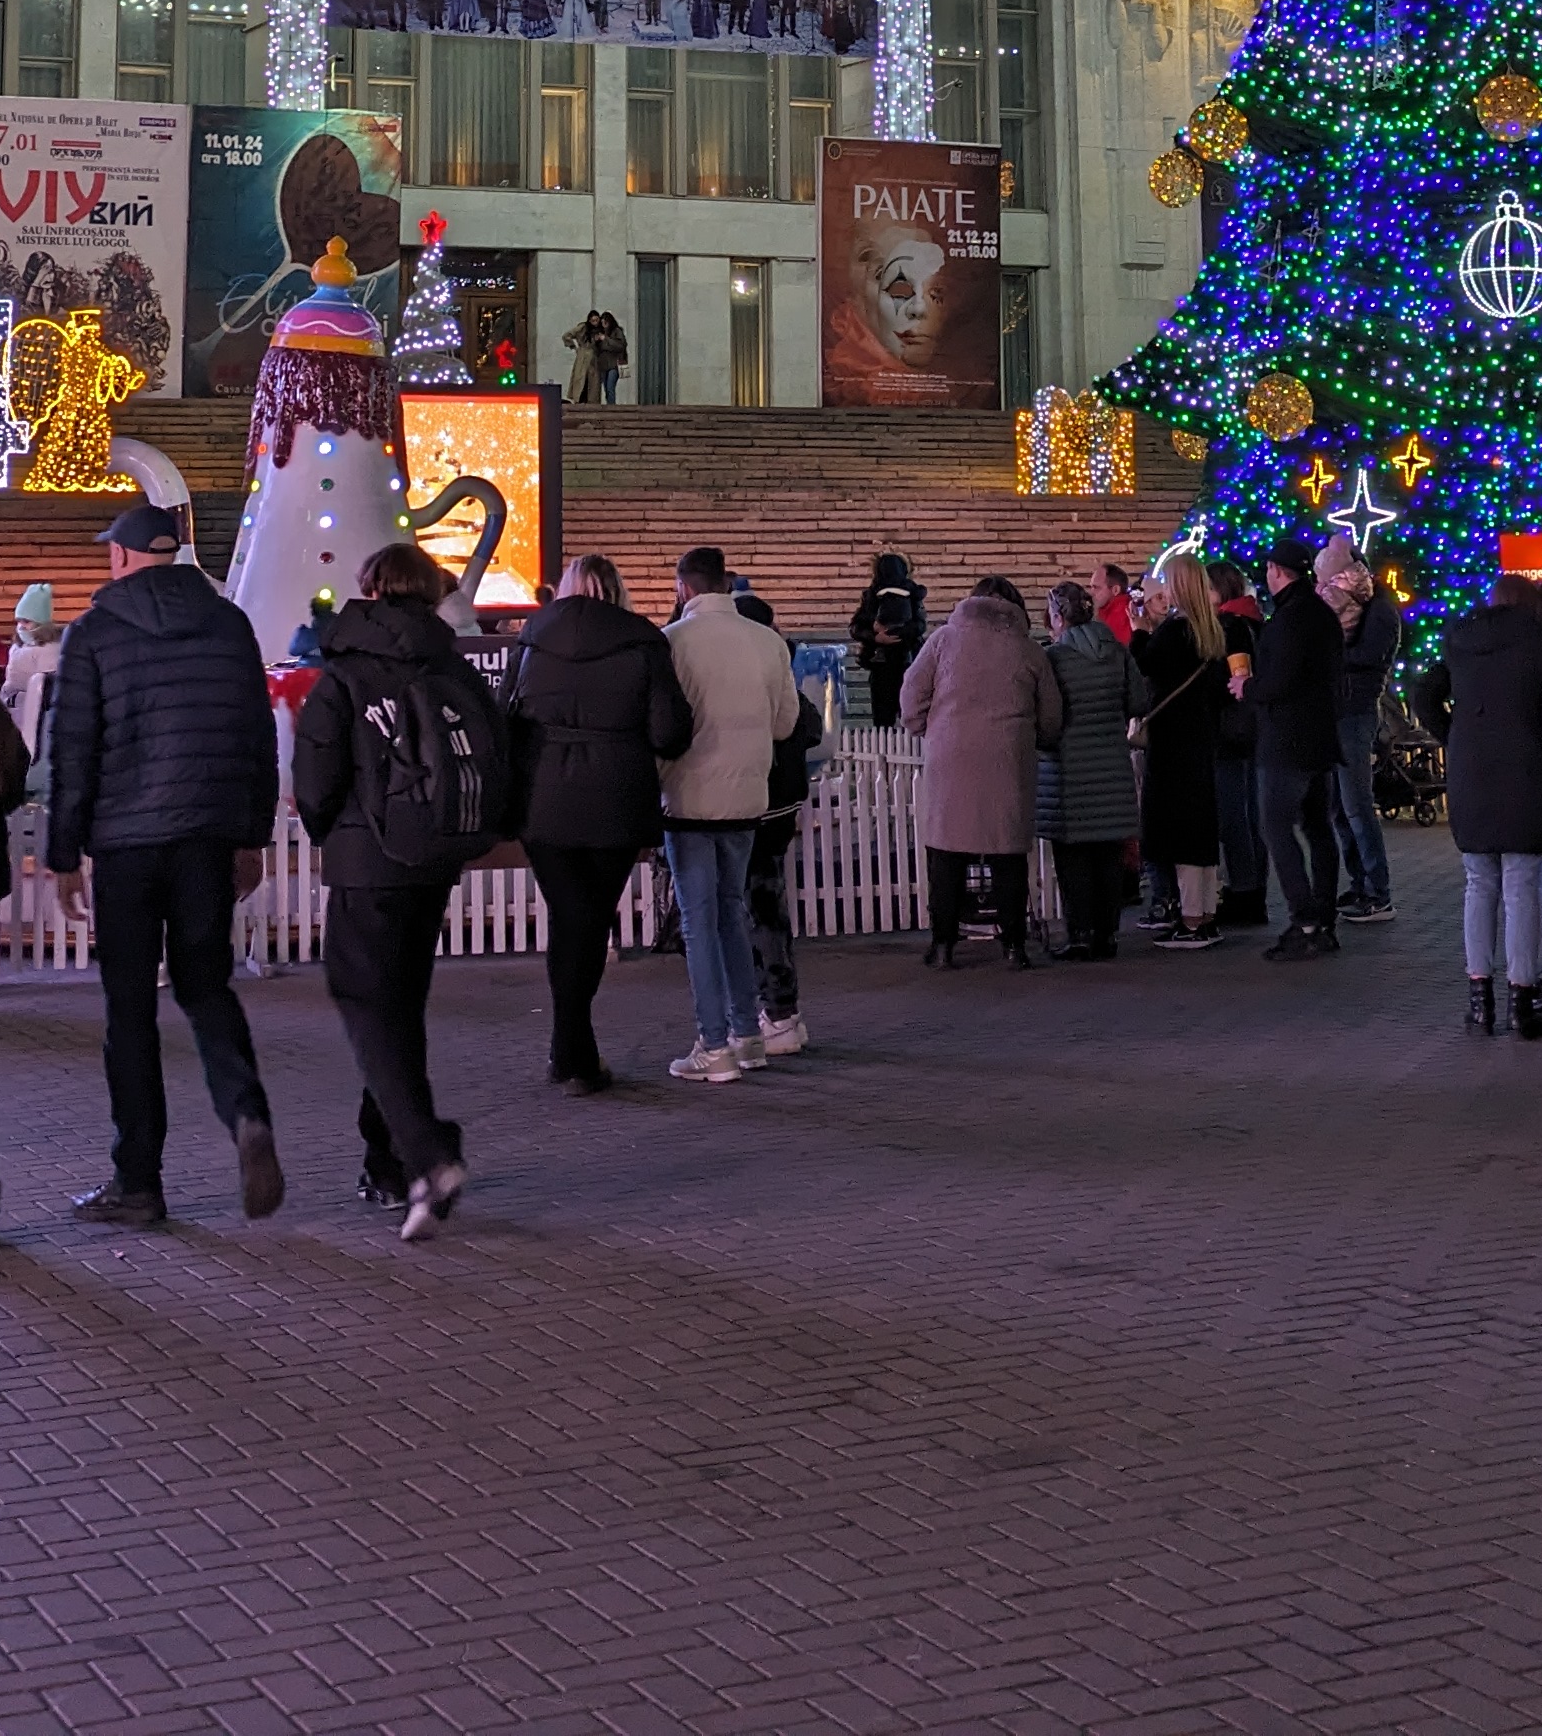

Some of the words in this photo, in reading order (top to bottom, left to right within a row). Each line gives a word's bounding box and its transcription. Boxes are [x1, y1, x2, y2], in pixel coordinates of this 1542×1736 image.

[201, 153, 220, 164] ora
[225, 150, 263, 166] 18.00
[853, 184, 976, 228] PAIAȚE
[21, 225, 44, 236] SAU
[45, 224, 126, 238] ÎNFRICOȘĂTOR
[15, 235, 71, 246] MISTERUL
[72, 236, 91, 246] LUI
[92, 237, 132, 247] GOGOL
[949, 247, 967, 258] ora
[967, 245, 998, 259] 18.00
